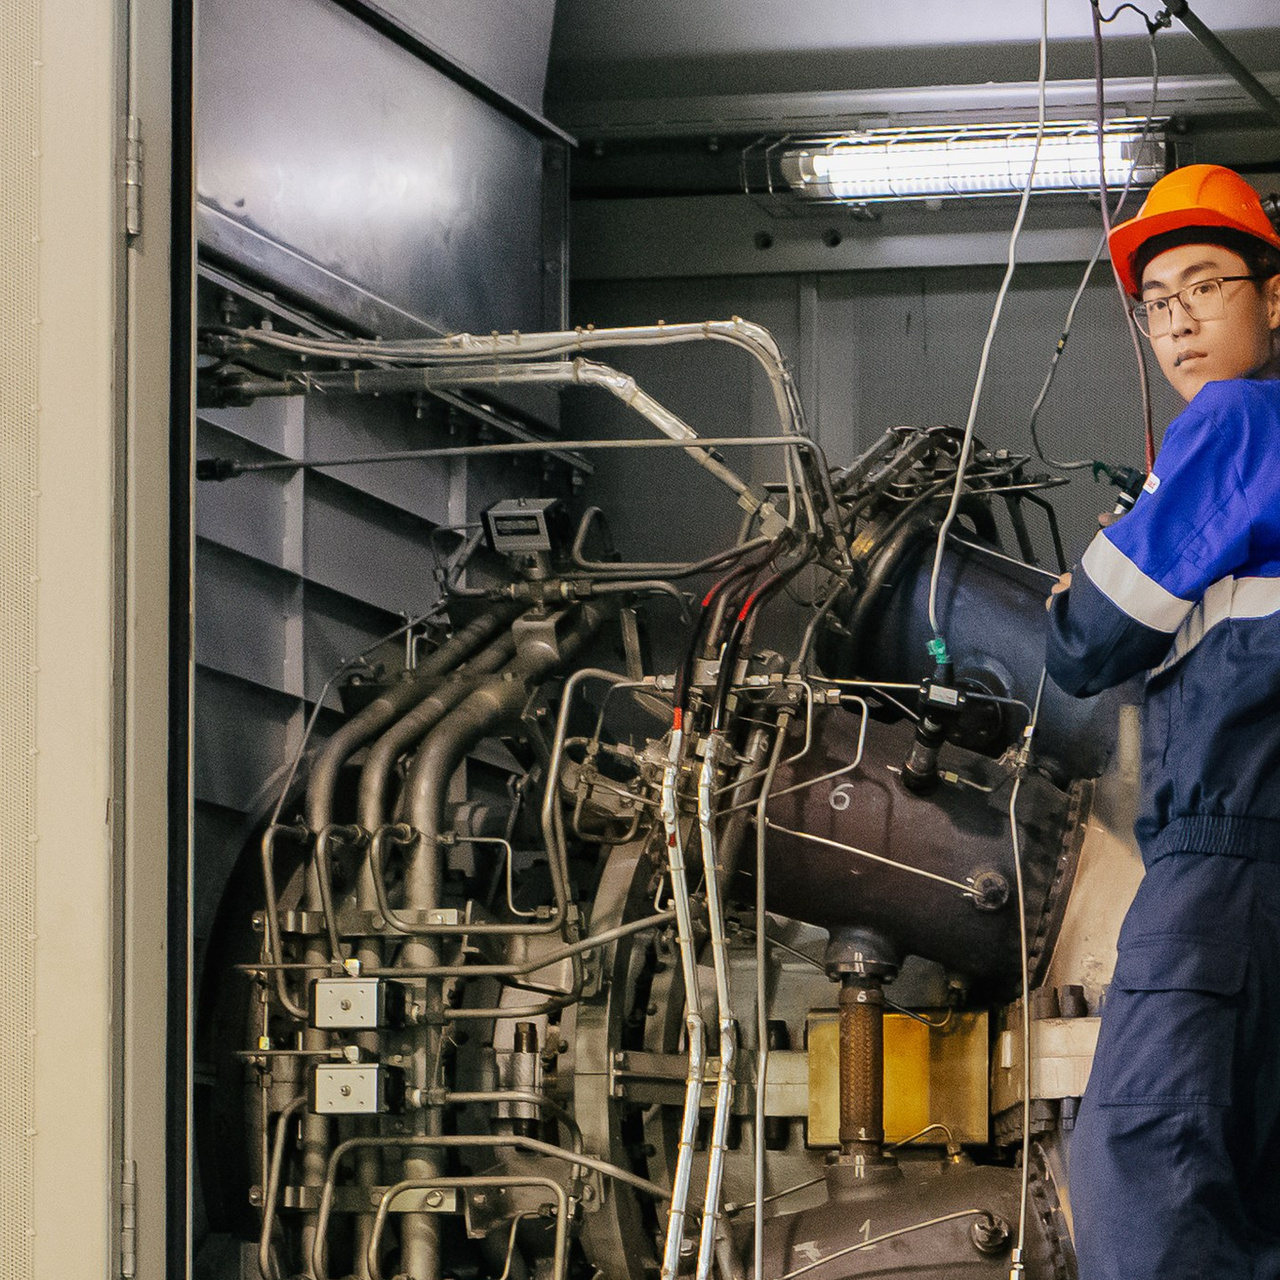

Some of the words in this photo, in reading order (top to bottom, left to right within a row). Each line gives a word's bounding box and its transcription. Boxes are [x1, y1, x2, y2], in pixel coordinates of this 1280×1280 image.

[829, 782, 854, 811] 6
[856, 990, 868, 1003] 6
[857, 1127, 867, 1141] 1
[858, 1218, 877, 1250] 1
